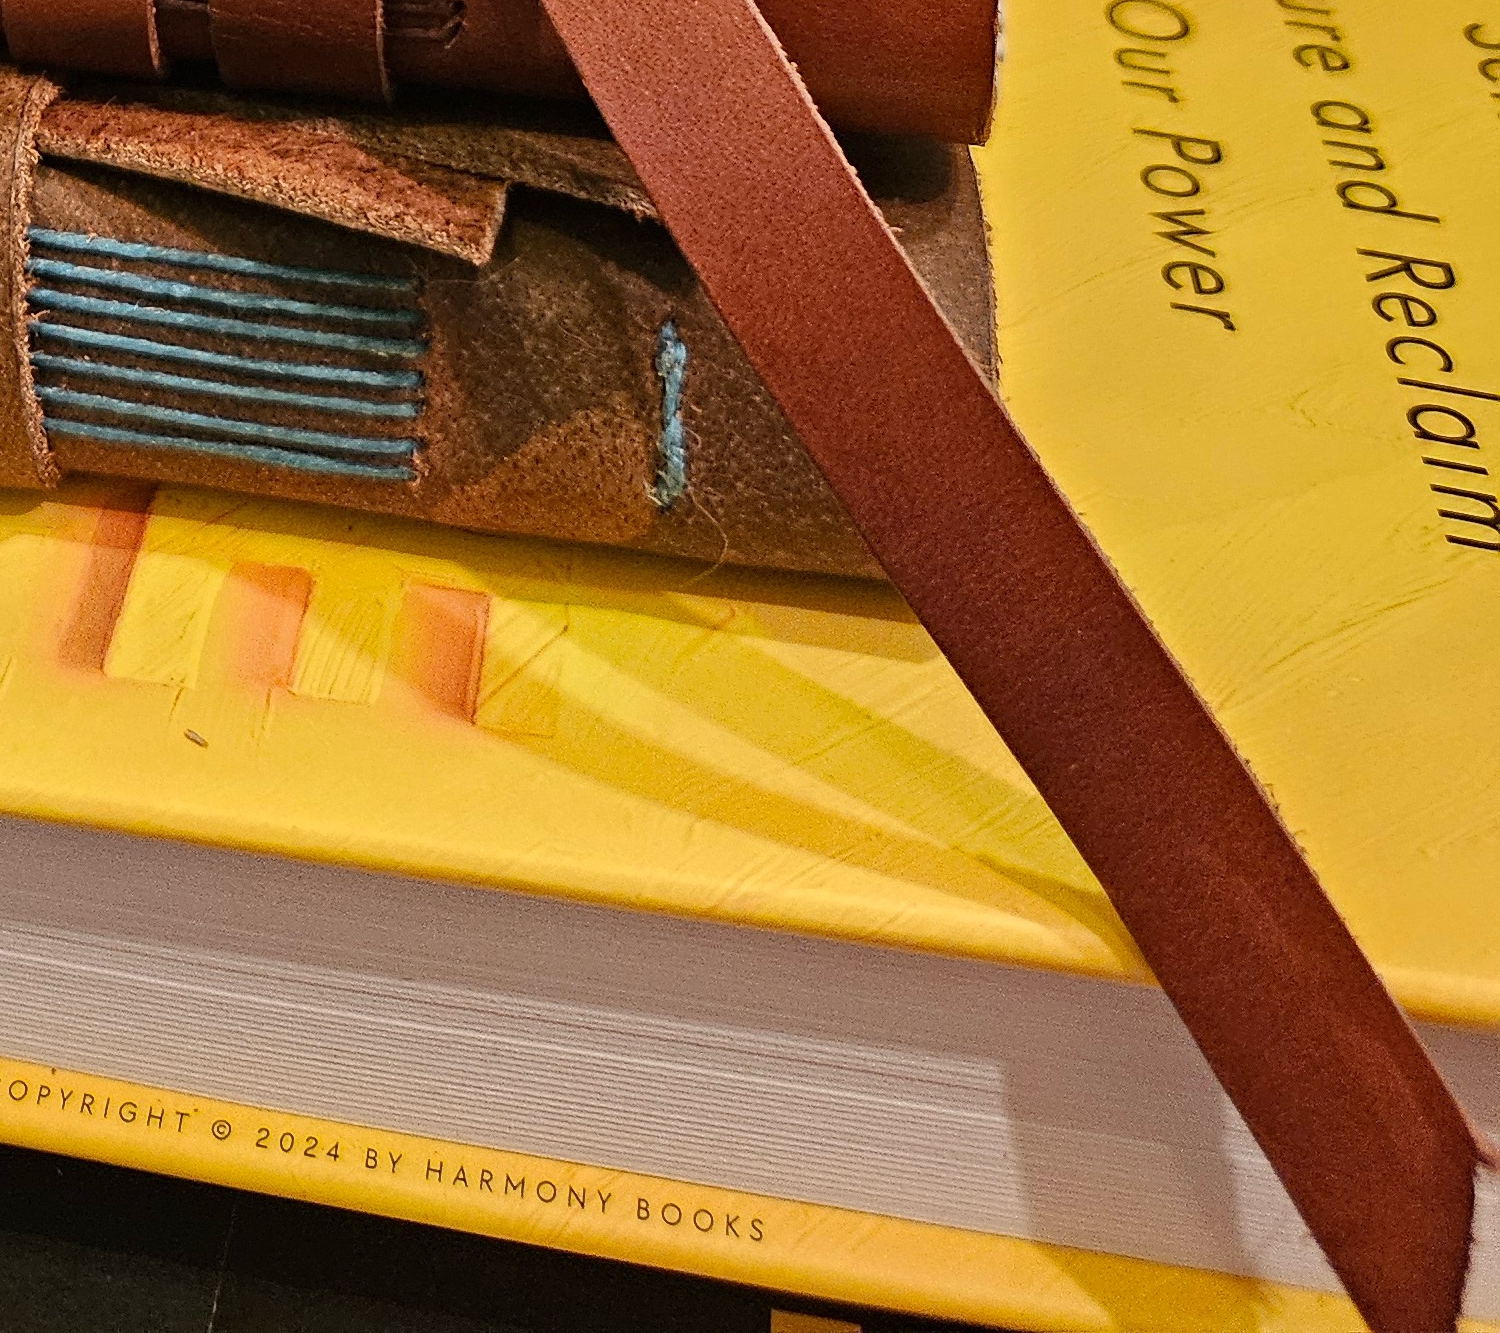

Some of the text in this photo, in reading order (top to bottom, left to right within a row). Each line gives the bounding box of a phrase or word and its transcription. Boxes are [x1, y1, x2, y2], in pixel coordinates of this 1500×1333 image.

[1309, 99, 1441, 225] and
[1132, 128, 1237, 332] Power
[255, 1127, 341, 1162] 2024
[364, 1148, 402, 1174] BY
[425, 1159, 612, 1213] HARMONY
[637, 1198, 764, 1242] BOOKS
